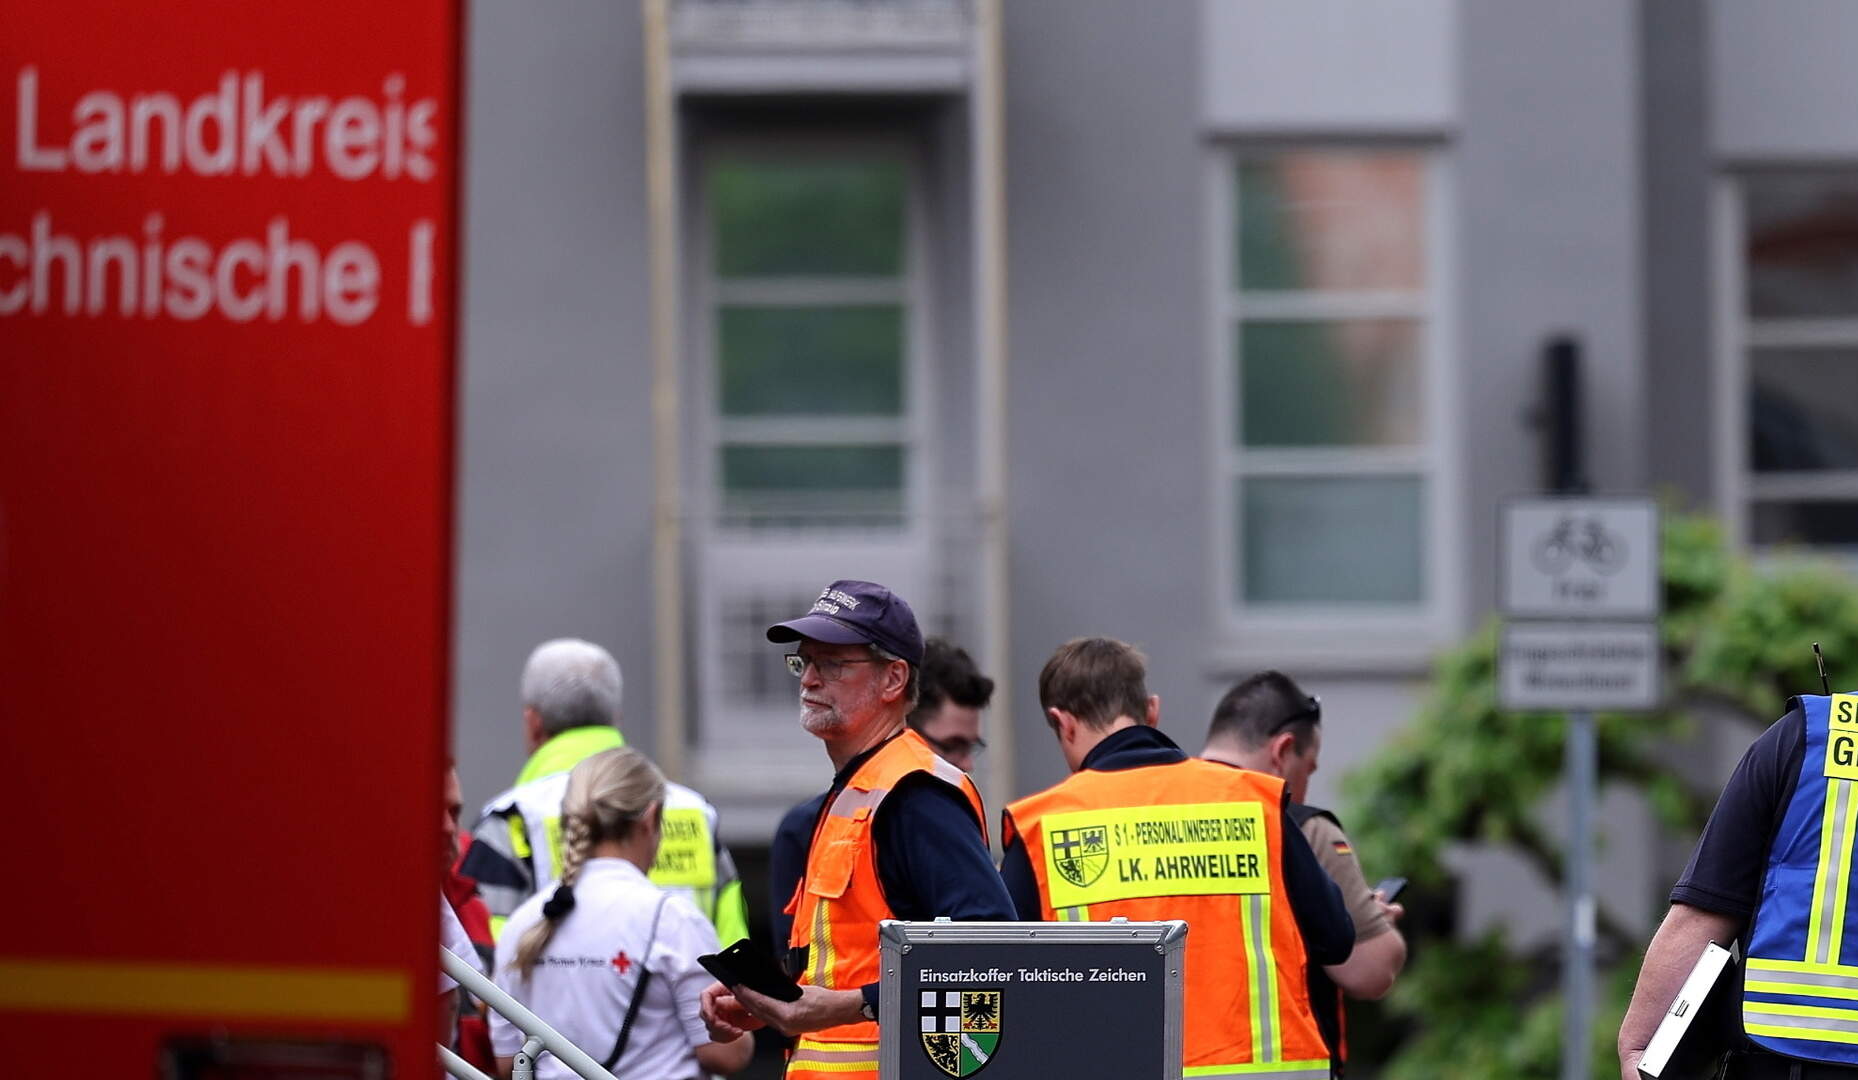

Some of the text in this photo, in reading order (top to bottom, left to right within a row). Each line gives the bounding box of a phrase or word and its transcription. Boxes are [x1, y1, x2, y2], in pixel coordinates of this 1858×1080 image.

[16, 64, 438, 183] Landkreis
[0, 207, 381, 326] chnische
[1114, 823, 1121, 846] S
[1123, 823, 1129, 846] 1
[1225, 817, 1256, 842] DIENST
[1118, 854, 1260, 882] LK. AHRWEILER
[919, 968, 1147, 983] Einsatzkoffer Taktische Zeichen
